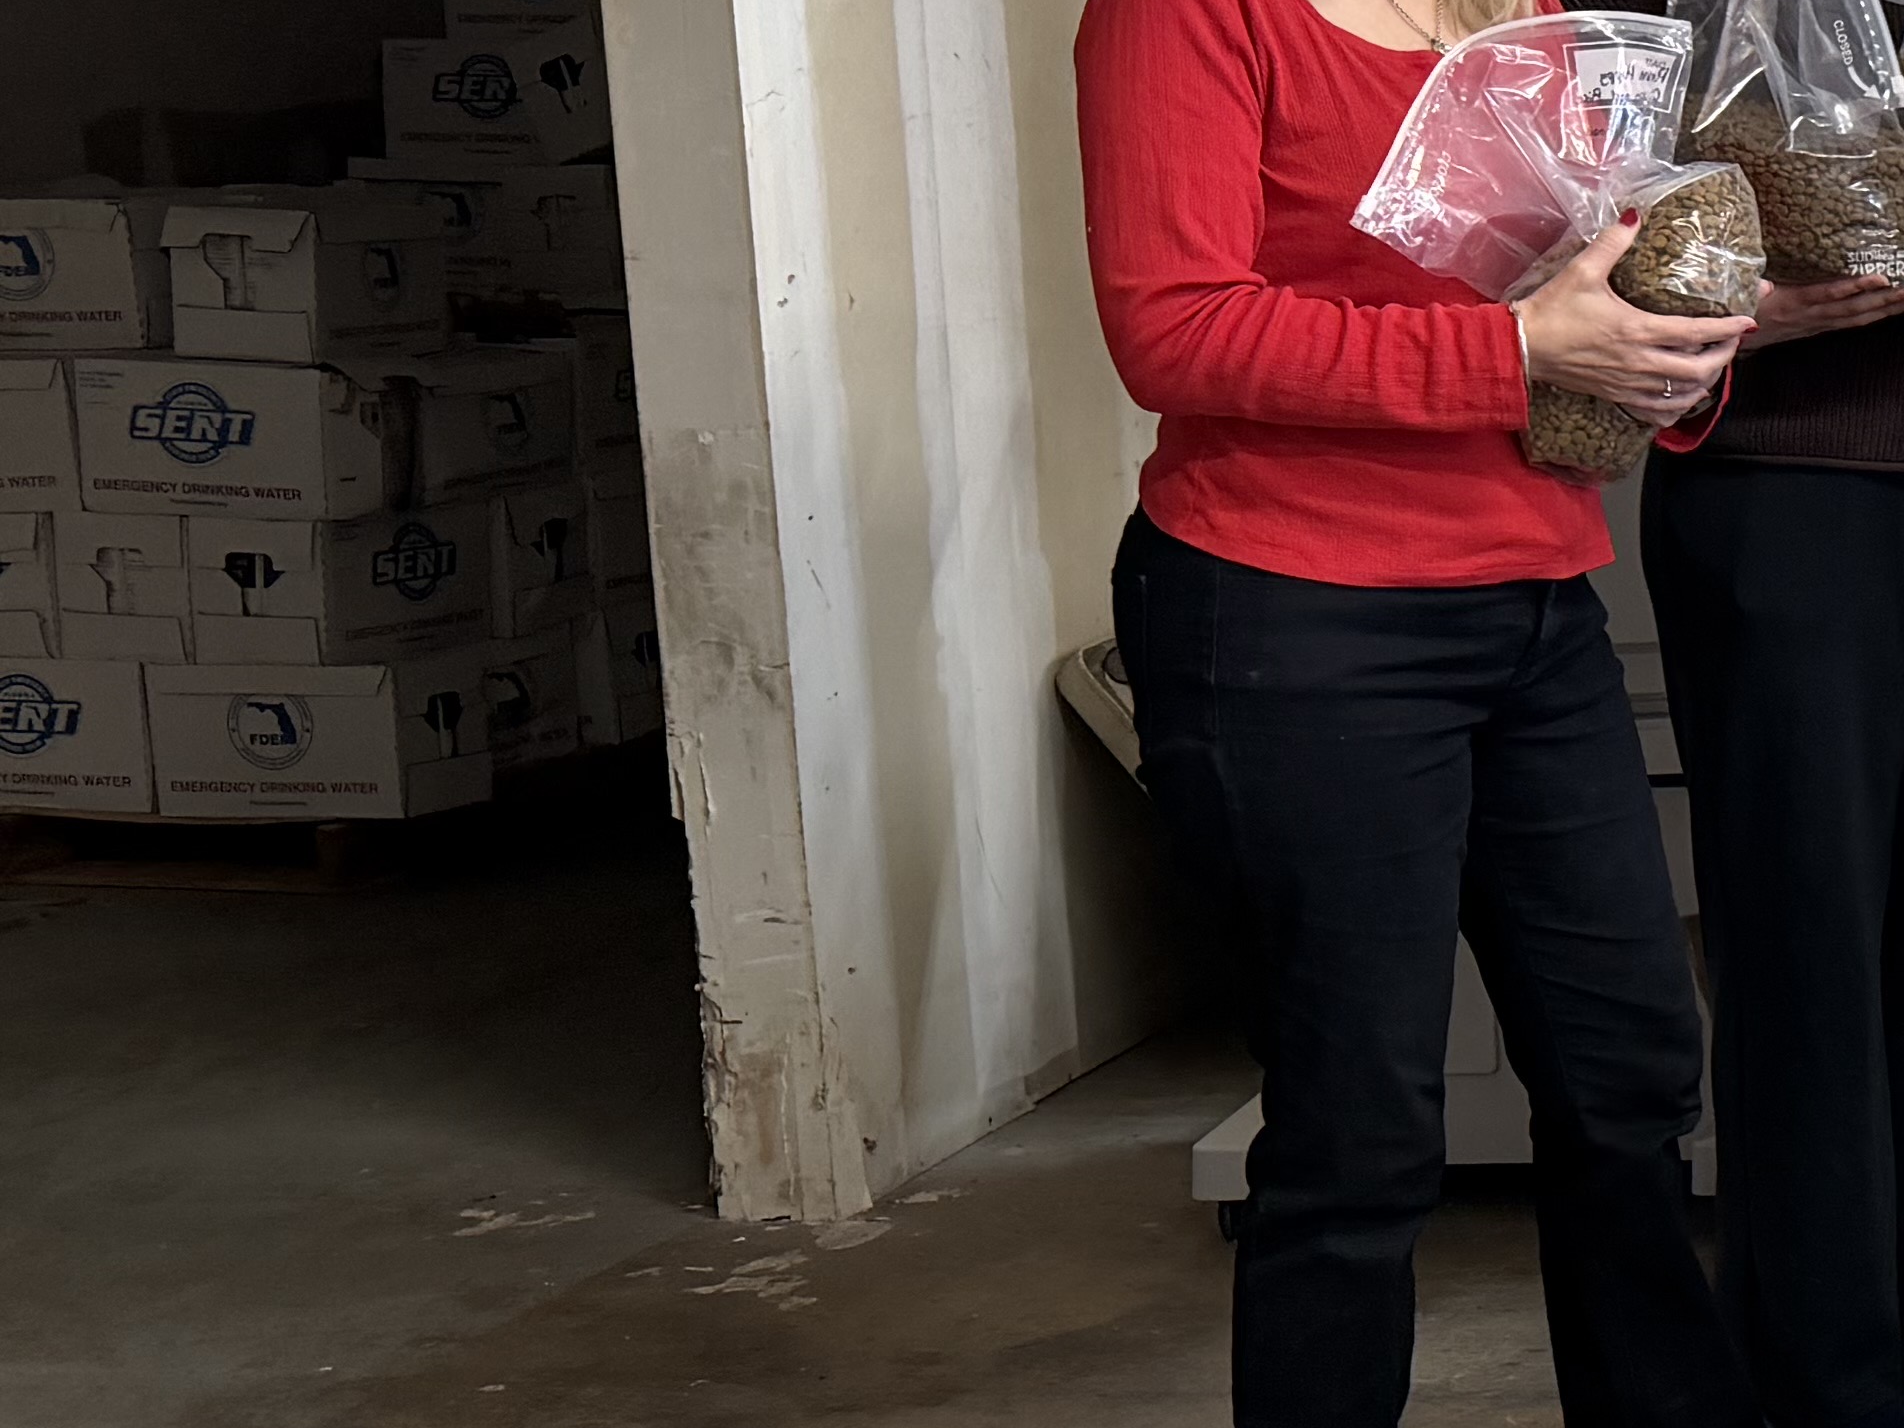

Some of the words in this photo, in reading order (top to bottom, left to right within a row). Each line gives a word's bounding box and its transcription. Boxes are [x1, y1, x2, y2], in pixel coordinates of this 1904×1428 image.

[1833, 19, 1853, 65] CLOSED
[93, 478, 178, 495] EMERGENCY
[182, 483, 250, 499] DRINKING
[253, 486, 302, 502] WATER
[84, 775, 131, 787] WATER
[332, 781, 378, 794] WATER
